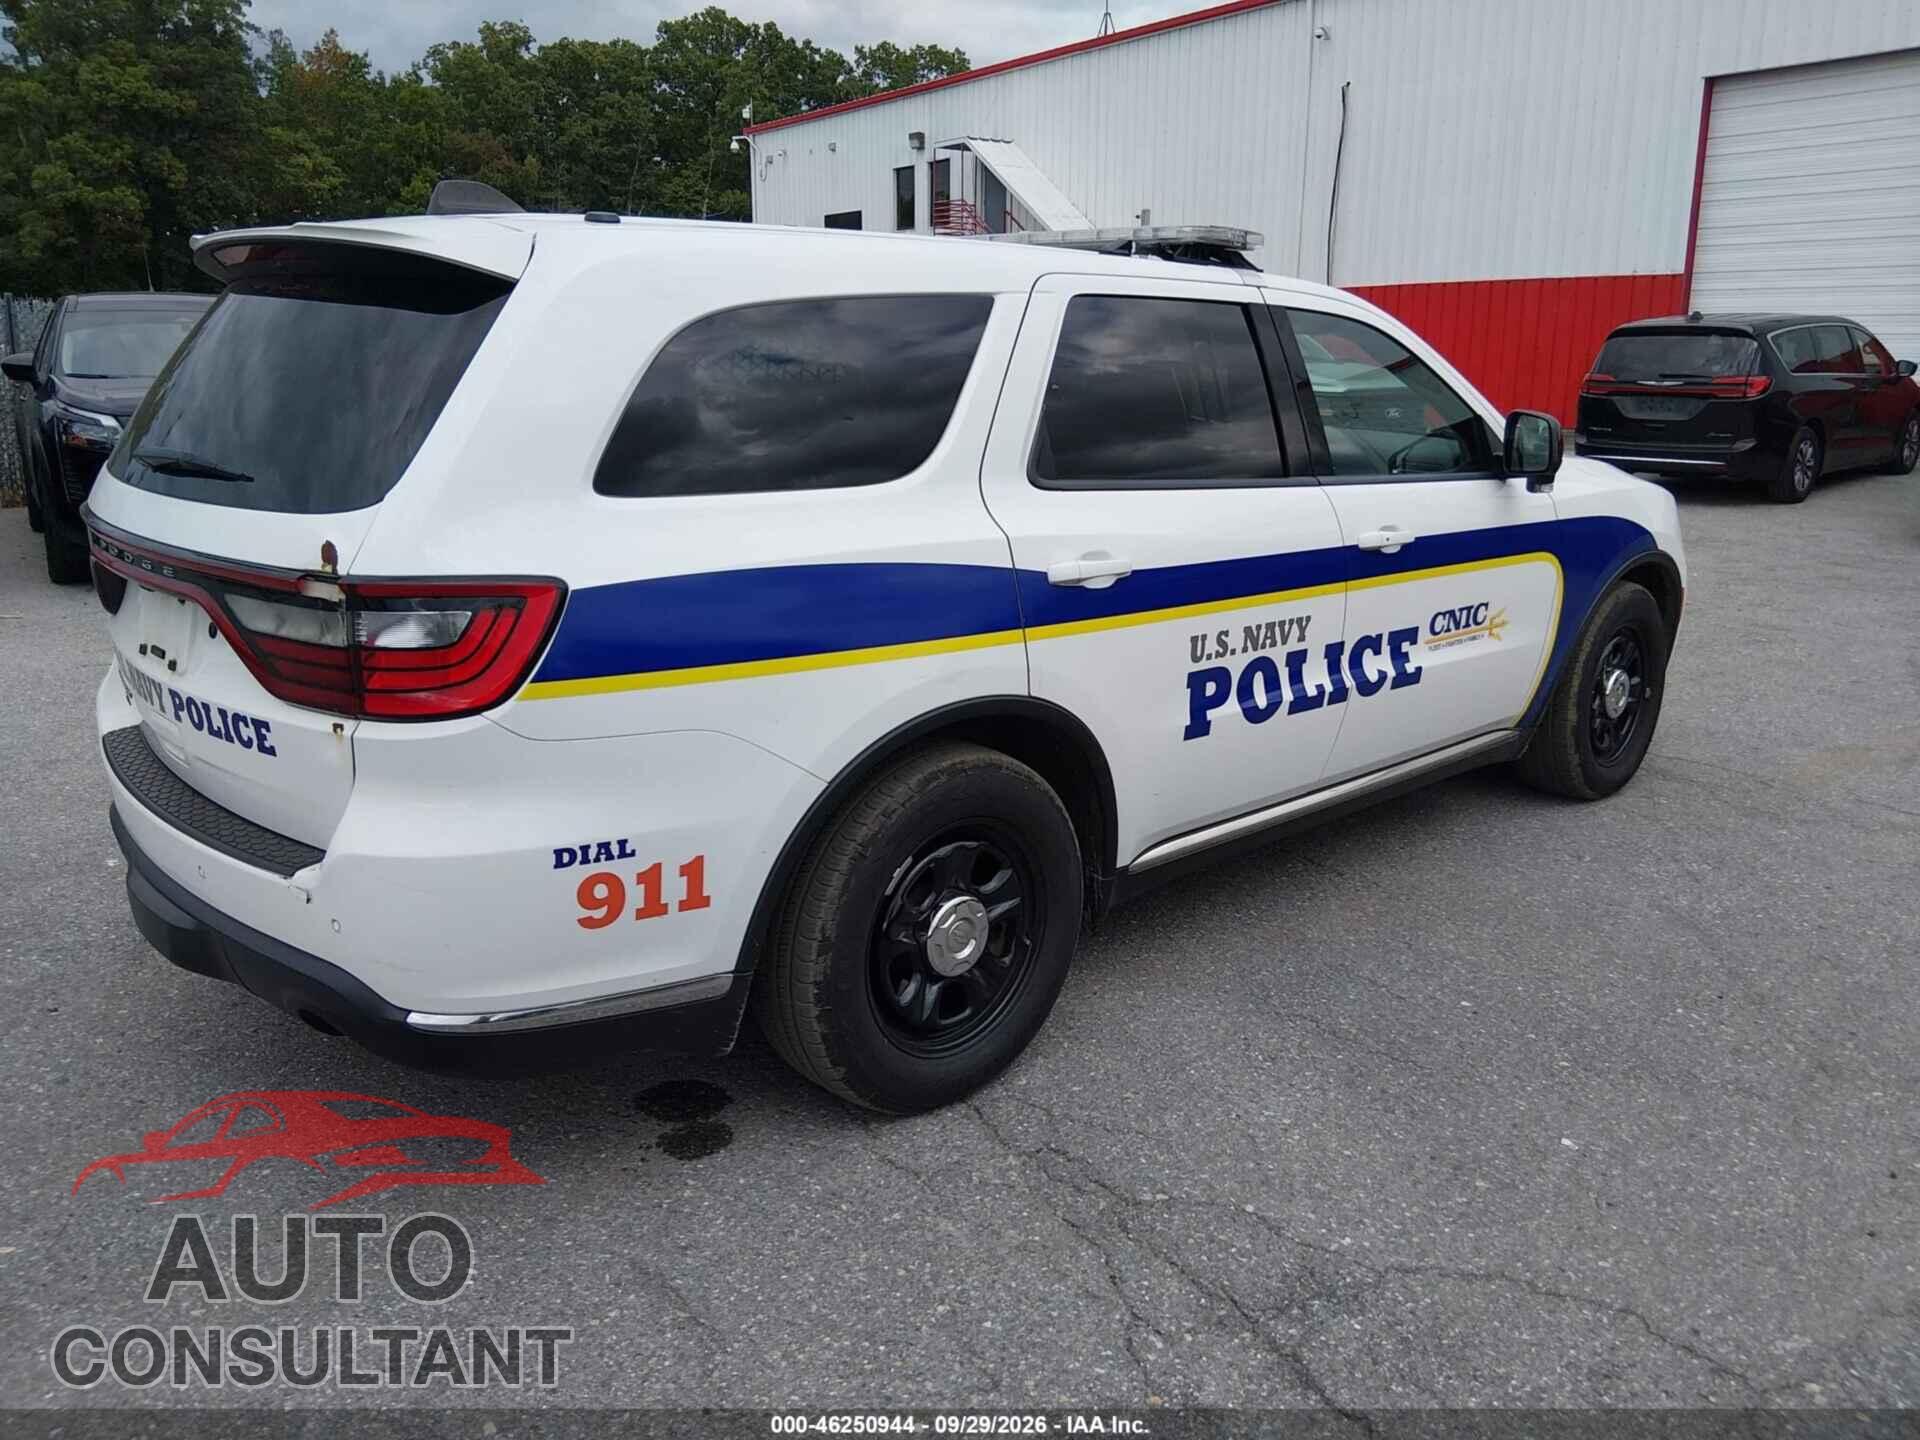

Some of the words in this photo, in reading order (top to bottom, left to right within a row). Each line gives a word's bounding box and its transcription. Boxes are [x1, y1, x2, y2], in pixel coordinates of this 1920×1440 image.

[1190, 630, 1237, 663] U.S.
[1241, 615, 1312, 654] NAVY
[1429, 602, 1489, 636] CNIC
[1183, 626, 1424, 741] POLICE
[168, 687, 278, 757] POLICE
[553, 838, 636, 869] DIAL
[576, 855, 711, 930] 911
